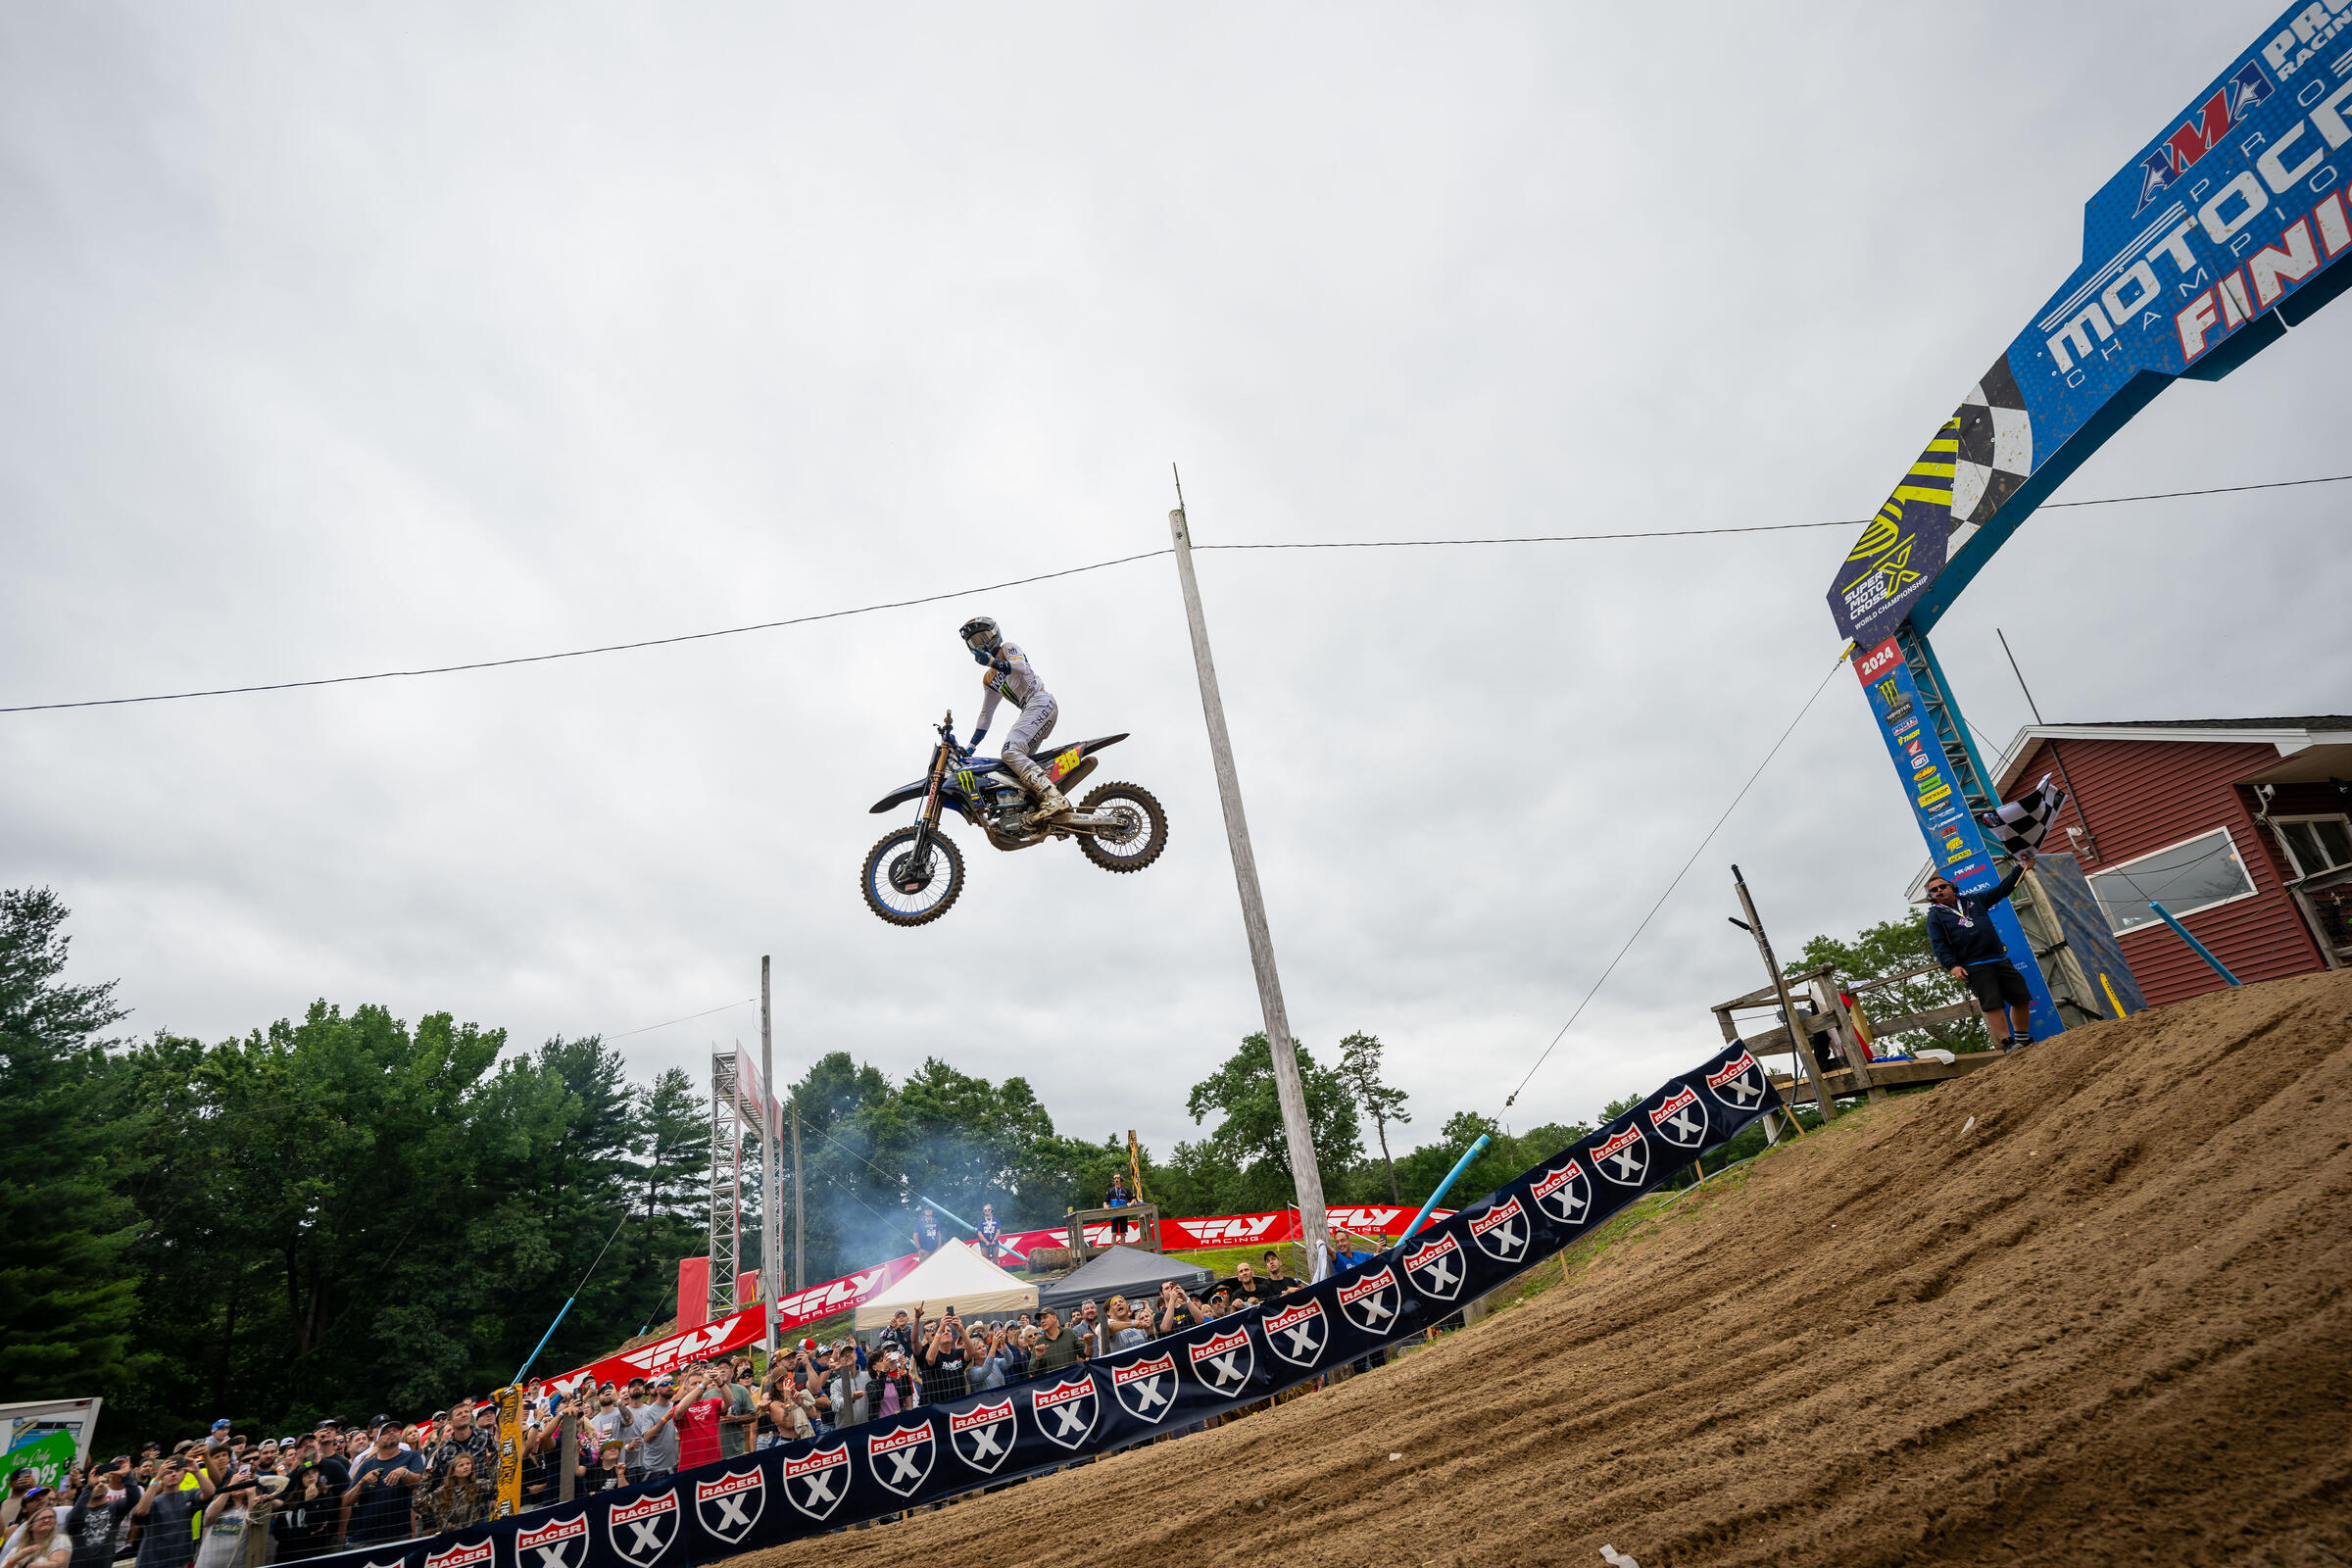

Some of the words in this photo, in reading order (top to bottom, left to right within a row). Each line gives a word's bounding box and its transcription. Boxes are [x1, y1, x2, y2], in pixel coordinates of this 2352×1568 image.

[2276, 4, 2352, 82] RACIN
[2131, 58, 2276, 220] AMA
[2173, 174, 2352, 365] FINI
[1844, 569, 1884, 605] SUPER
[1849, 579, 1884, 612] MOTO
[1854, 610, 1879, 631] WORLD
[1878, 574, 1930, 615] CHAMPIONSHIP
[1849, 588, 1888, 620] CROSS
[1862, 646, 1894, 676] 2024
[1925, 786, 1949, 803] DUNLOP
[1711, 1058, 1750, 1086] RACER
[1727, 1072, 1761, 1104] X
[1654, 1094, 1692, 1122] RACER
[1667, 1107, 1703, 1142] X
[1595, 1132, 1637, 1159] RACER
[1609, 1145, 1644, 1180] X
[1537, 1168, 1577, 1196] RACER
[1550, 1182, 1586, 1218] X
[1177, 1215, 1277, 1240] FLY
[1474, 1204, 1518, 1233] RACER
[1200, 1235, 1259, 1245] RACING
[1490, 1219, 1525, 1256] X
[1409, 1241, 1453, 1268] RACER
[778, 1266, 884, 1316] FLY
[1343, 1276, 1391, 1301] RACER
[1424, 1256, 1459, 1294] X
[800, 1296, 866, 1322] RACING
[1269, 1305, 1317, 1331] RACER
[1357, 1291, 1394, 1326] X
[620, 1315, 742, 1370] FLY
[1196, 1336, 1245, 1359] RACER
[1284, 1321, 1319, 1358] X
[651, 1347, 721, 1375] RACING
[1118, 1361, 1169, 1382] RACER
[1209, 1350, 1245, 1386] X
[1039, 1385, 1091, 1405] RACER
[1133, 1375, 1168, 1412] X
[956, 1407, 1009, 1428] RACER
[1052, 1399, 1088, 1438] X
[502, 1437, 513, 1455] THE
[874, 1430, 927, 1450] RACER
[968, 1423, 1004, 1461] X
[501, 1452, 517, 1486] WICK
[789, 1452, 843, 1474] RACER
[887, 1446, 922, 1484] X
[702, 1476, 759, 1497] RACER
[803, 1470, 837, 1507] X
[500, 1497, 511, 1517] THE
[614, 1499, 673, 1521] RACER
[715, 1493, 751, 1531] X
[522, 1524, 581, 1546] RACER
[629, 1516, 663, 1555] X
